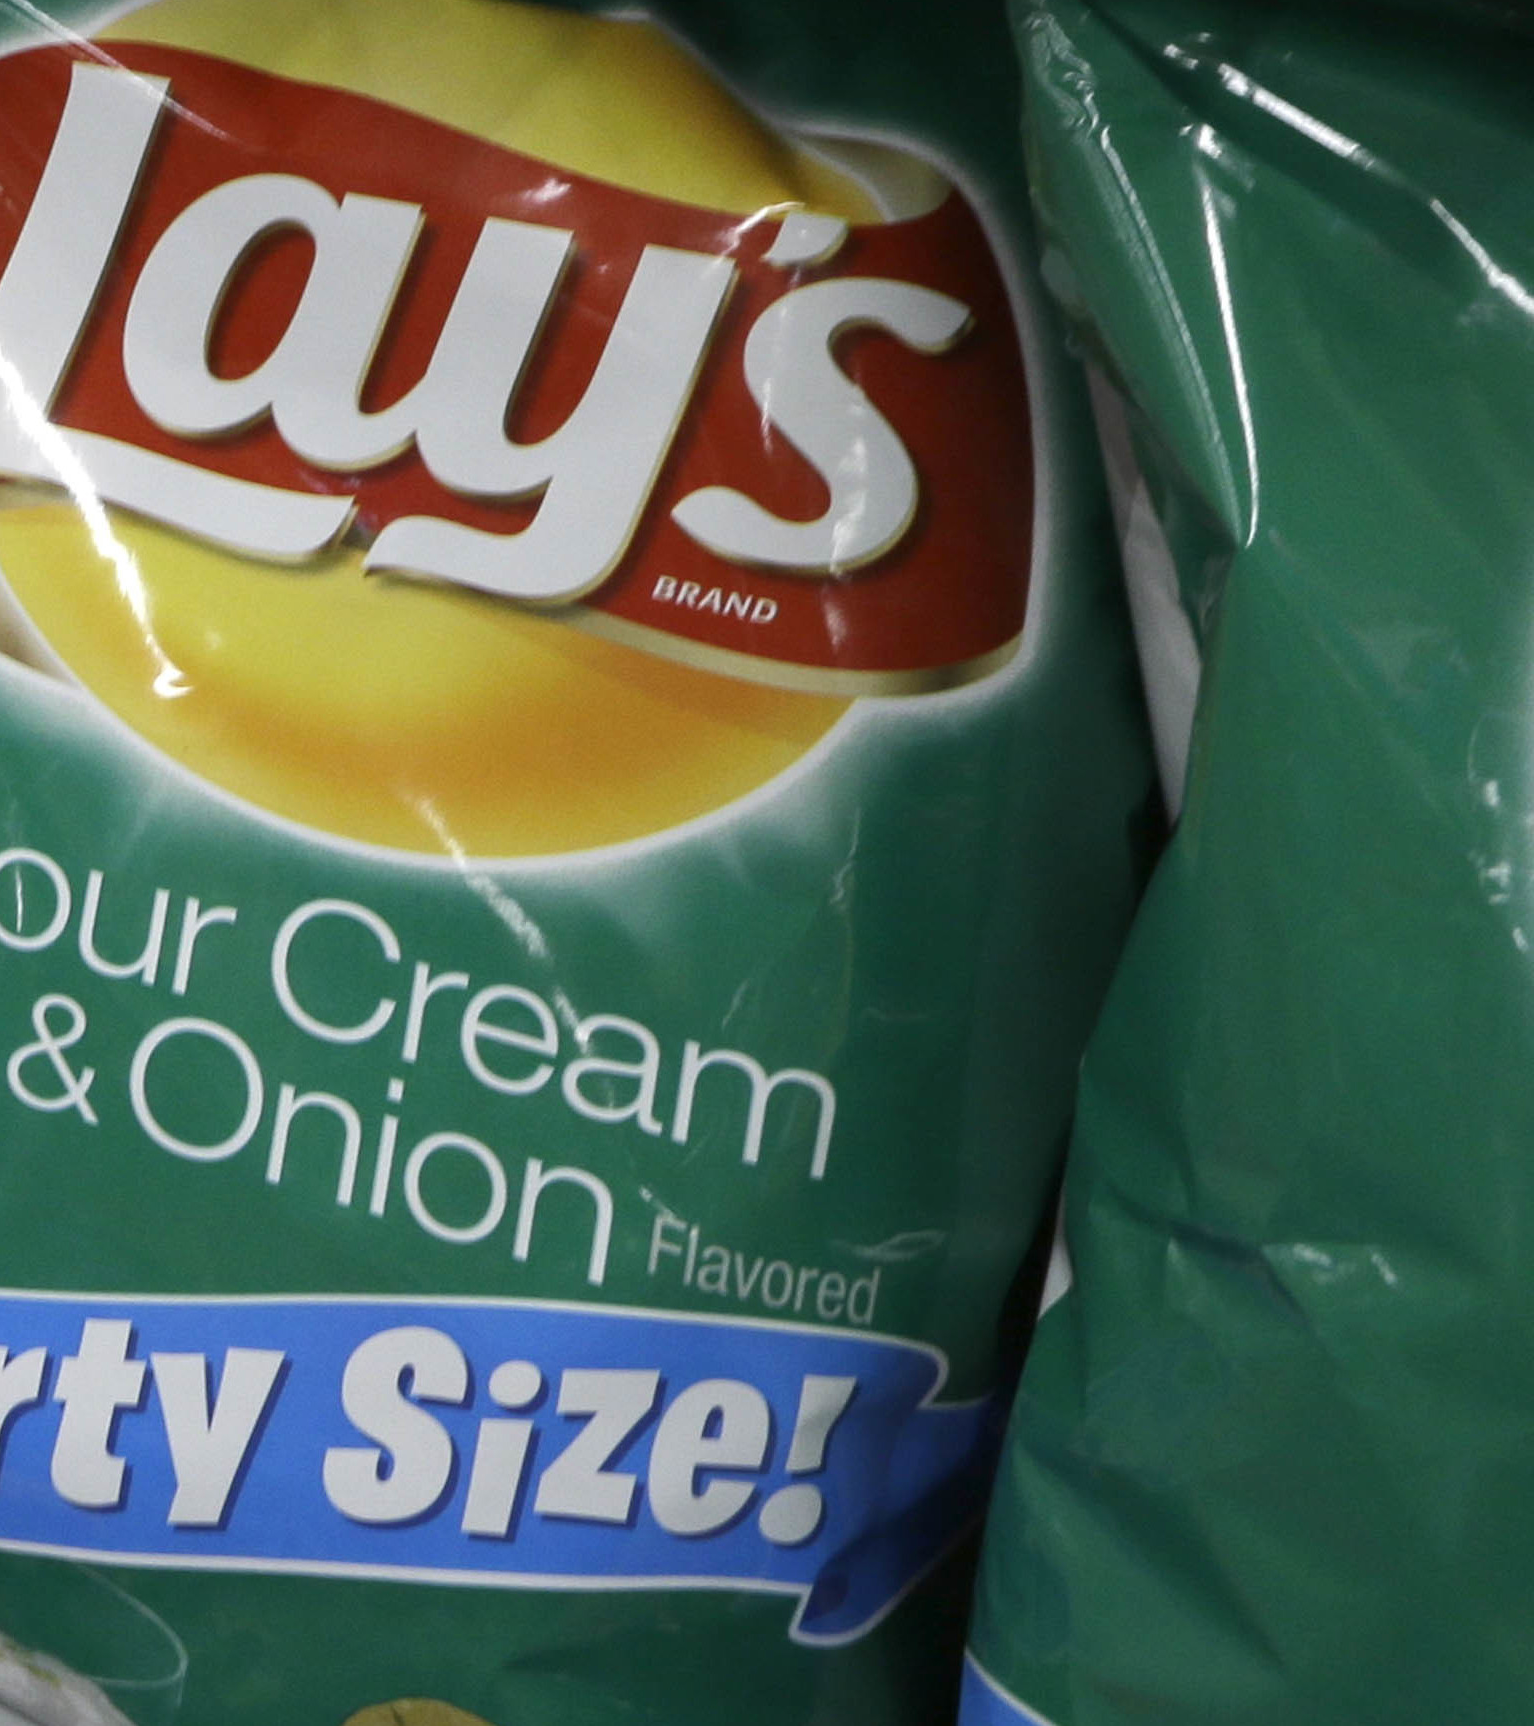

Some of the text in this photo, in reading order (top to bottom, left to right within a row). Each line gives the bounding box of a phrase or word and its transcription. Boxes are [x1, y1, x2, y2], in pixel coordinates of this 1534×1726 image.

[652, 571, 781, 628] BRAND
[5, 994, 883, 1330] & Onion Flavored
[272, 896, 842, 1182] Cream
[322, 1323, 858, 1550] Size!
